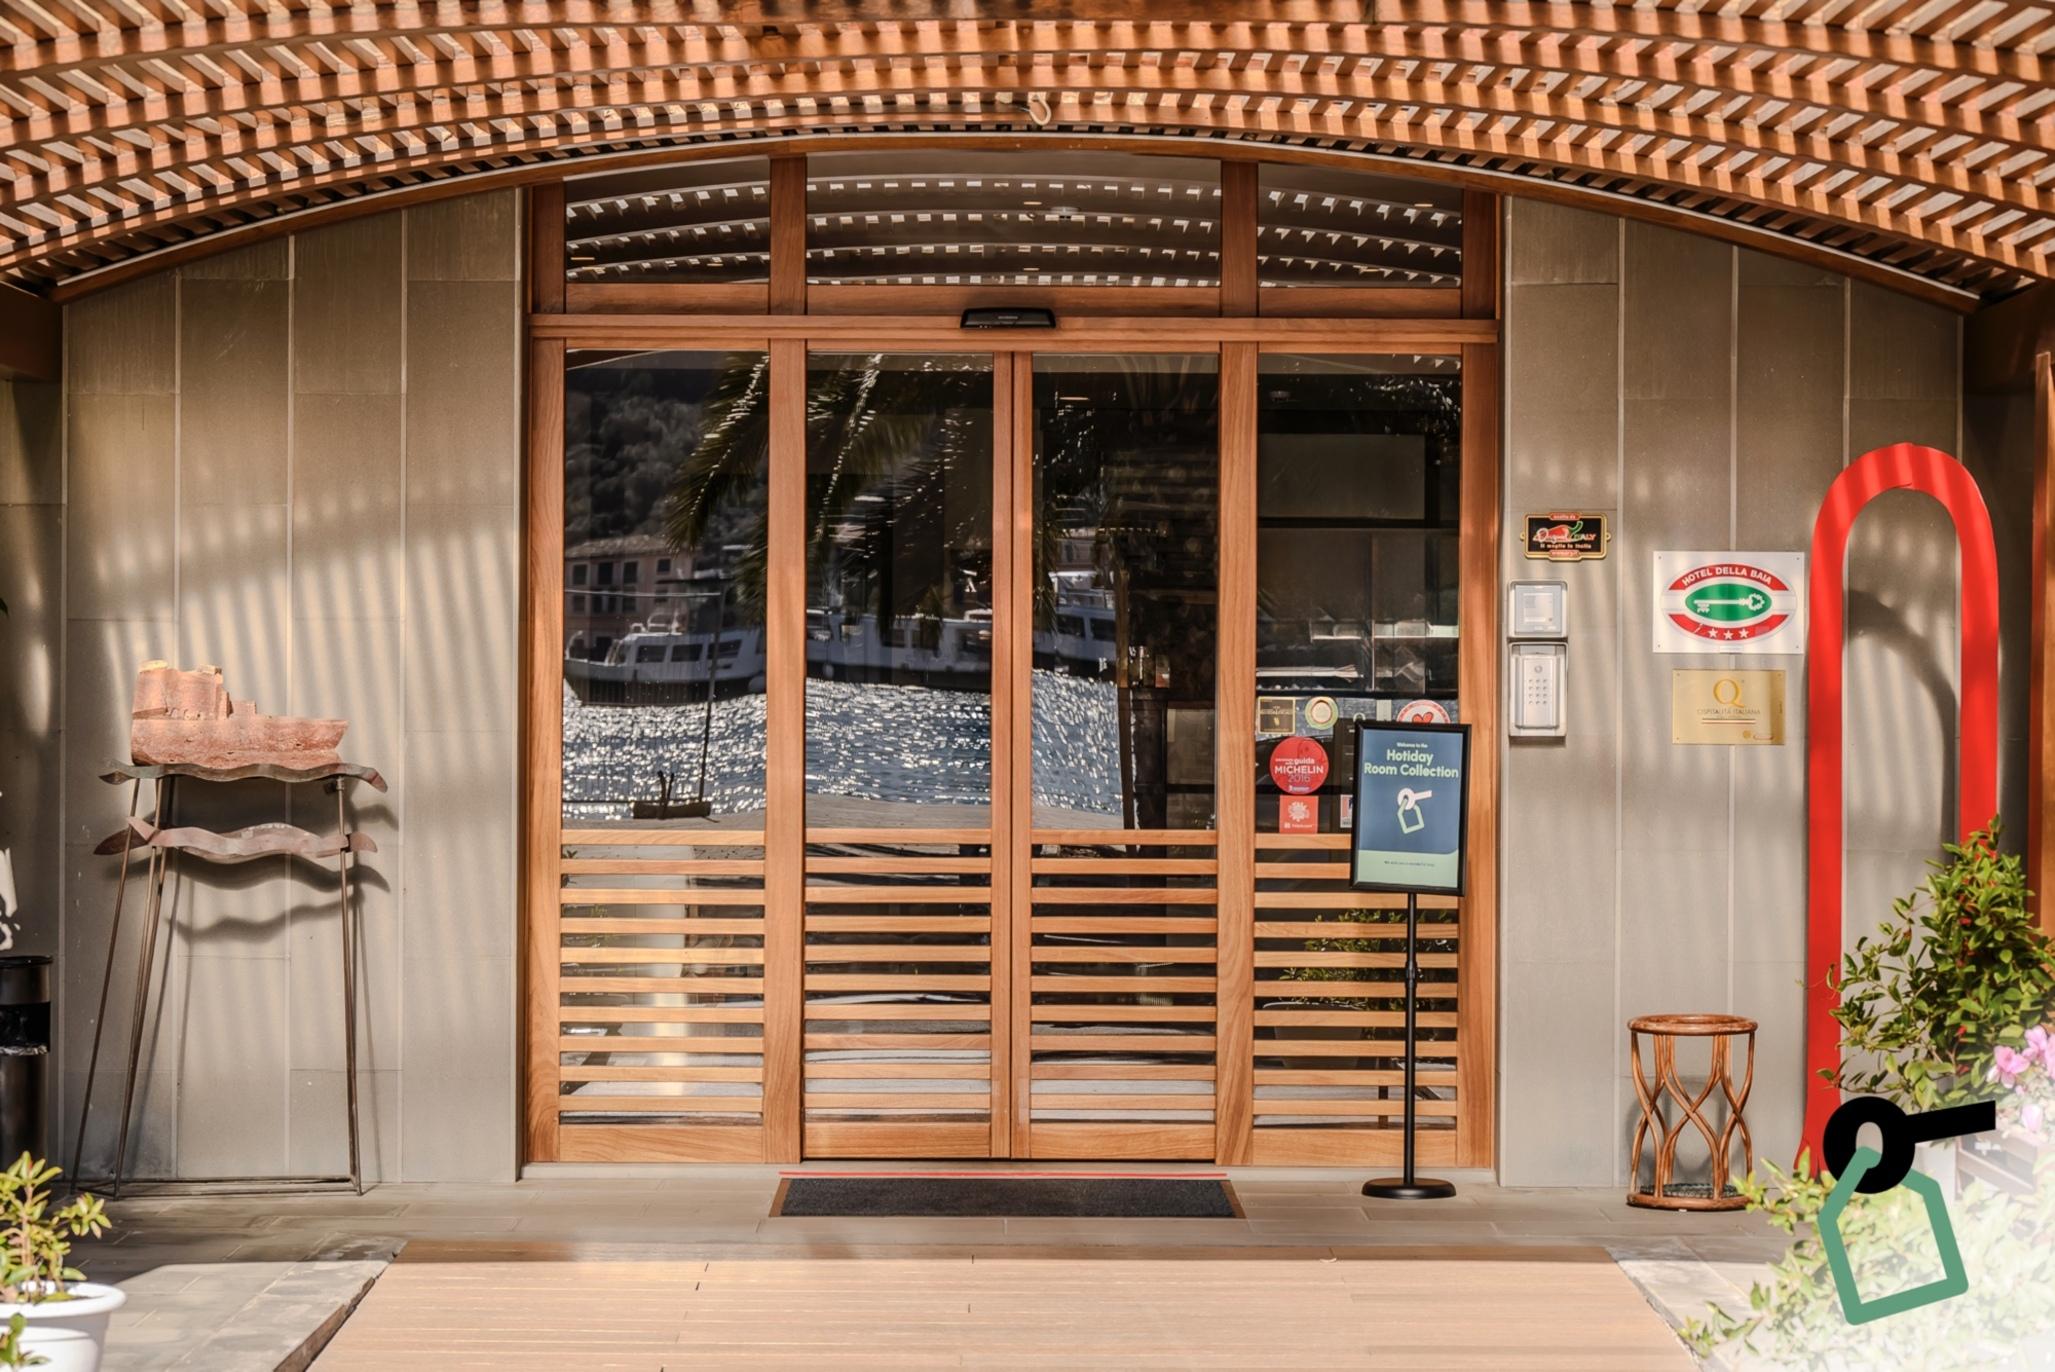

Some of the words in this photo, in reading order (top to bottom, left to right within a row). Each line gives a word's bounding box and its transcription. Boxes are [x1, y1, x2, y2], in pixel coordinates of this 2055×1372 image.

[1682, 567, 1713, 586] HOTEL
[1715, 566, 1747, 576] DELLA
[1750, 570, 1772, 585] BAIA
[1712, 678, 1745, 708] Q
[1294, 757, 1315, 766] guida
[1386, 748, 1434, 766] Hotiday
[1274, 765, 1324, 774] MICHELIN
[1363, 762, 1398, 775] Room
[1400, 763, 1459, 778] Collection
